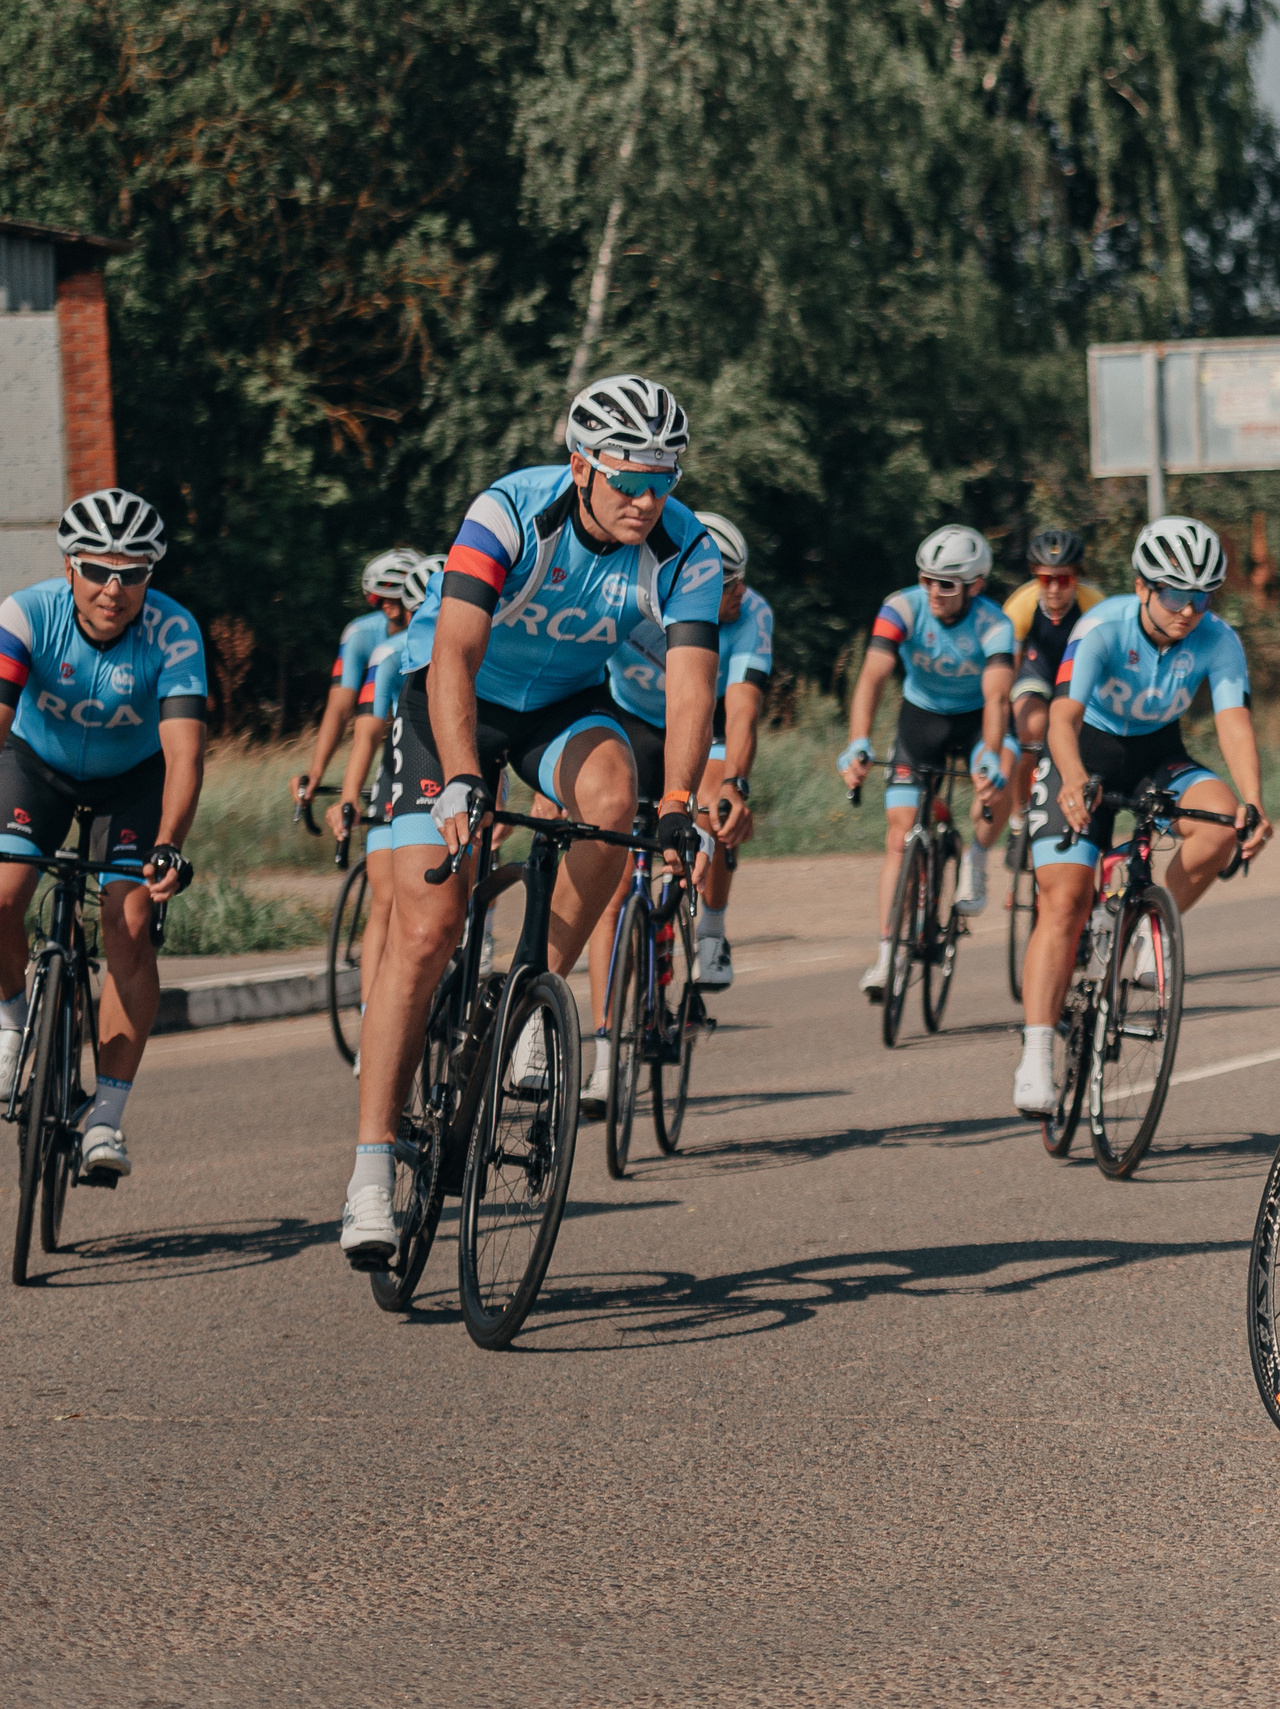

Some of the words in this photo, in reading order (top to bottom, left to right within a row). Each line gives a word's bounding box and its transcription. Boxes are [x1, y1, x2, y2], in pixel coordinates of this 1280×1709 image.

[138, 603, 199, 669] RCA
[503, 600, 617, 644] RCA
[912, 652, 981, 677] RCA
[37, 690, 143, 729] RCA
[1099, 677, 1192, 722] RCA
